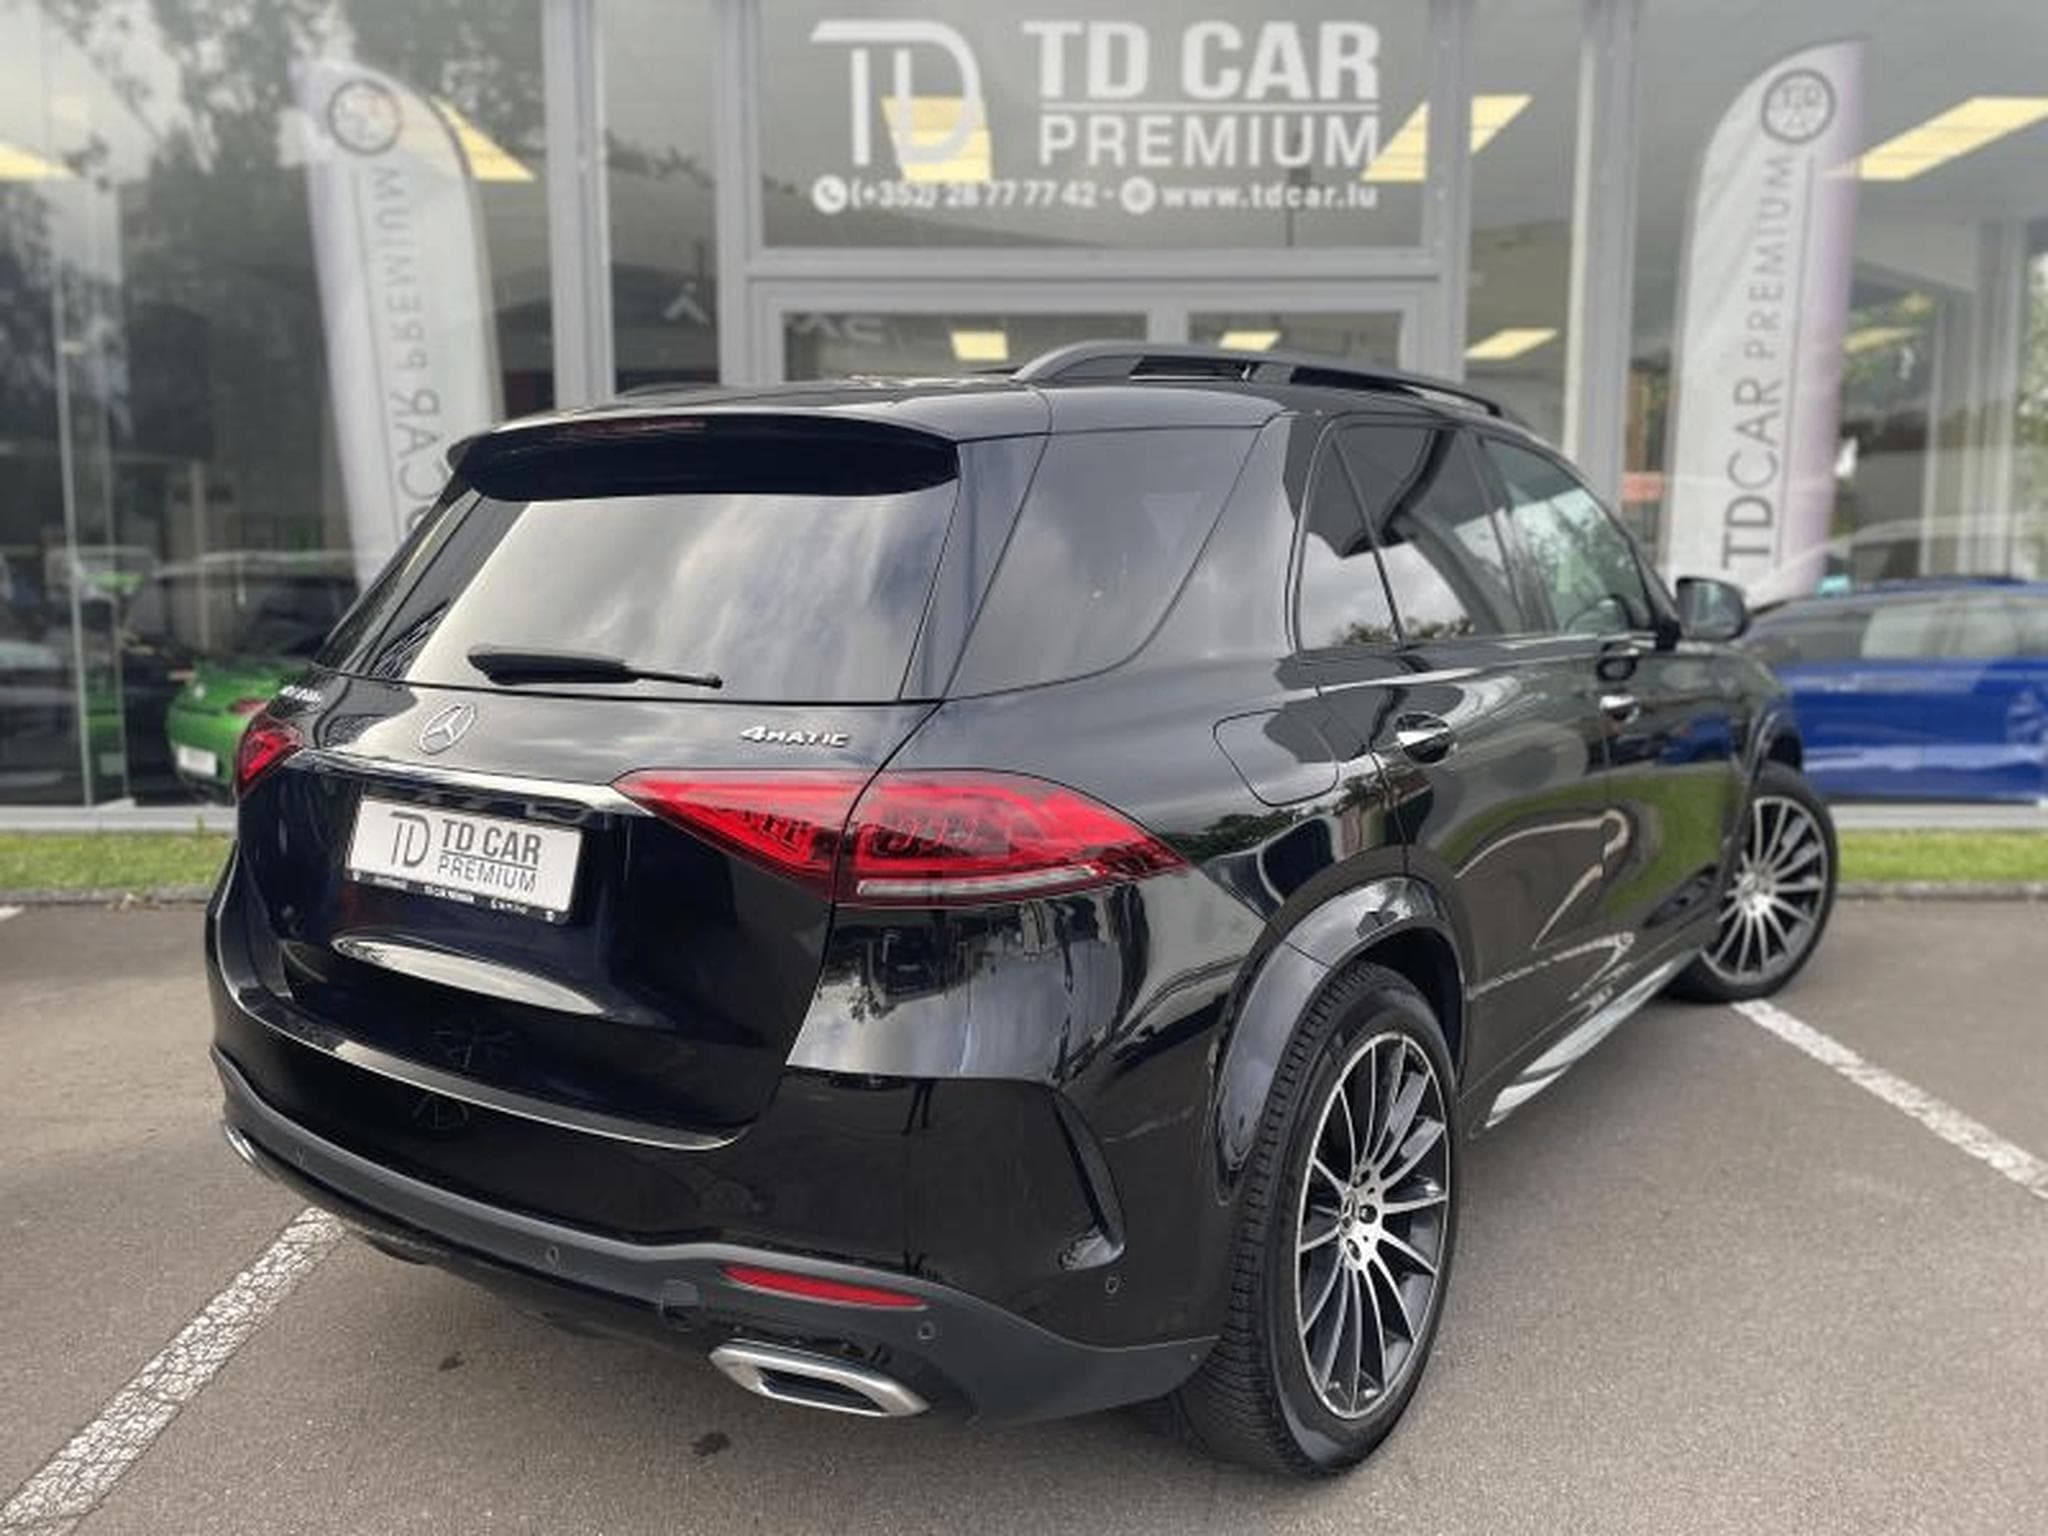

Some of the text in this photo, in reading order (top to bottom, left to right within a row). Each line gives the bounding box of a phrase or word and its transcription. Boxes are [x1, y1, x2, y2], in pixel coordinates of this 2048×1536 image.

[1022, 20, 1381, 101] TD CAR
[1039, 115, 1381, 167] PREMIUM
[1161, 183, 1379, 209] www.tdcar.lu
[1721, 154, 1794, 570] TDCAR PREMIUM
[740, 725, 850, 747] 4MATIC
[441, 818, 542, 866] TD CAR
[437, 856, 537, 894] PREMIUM
